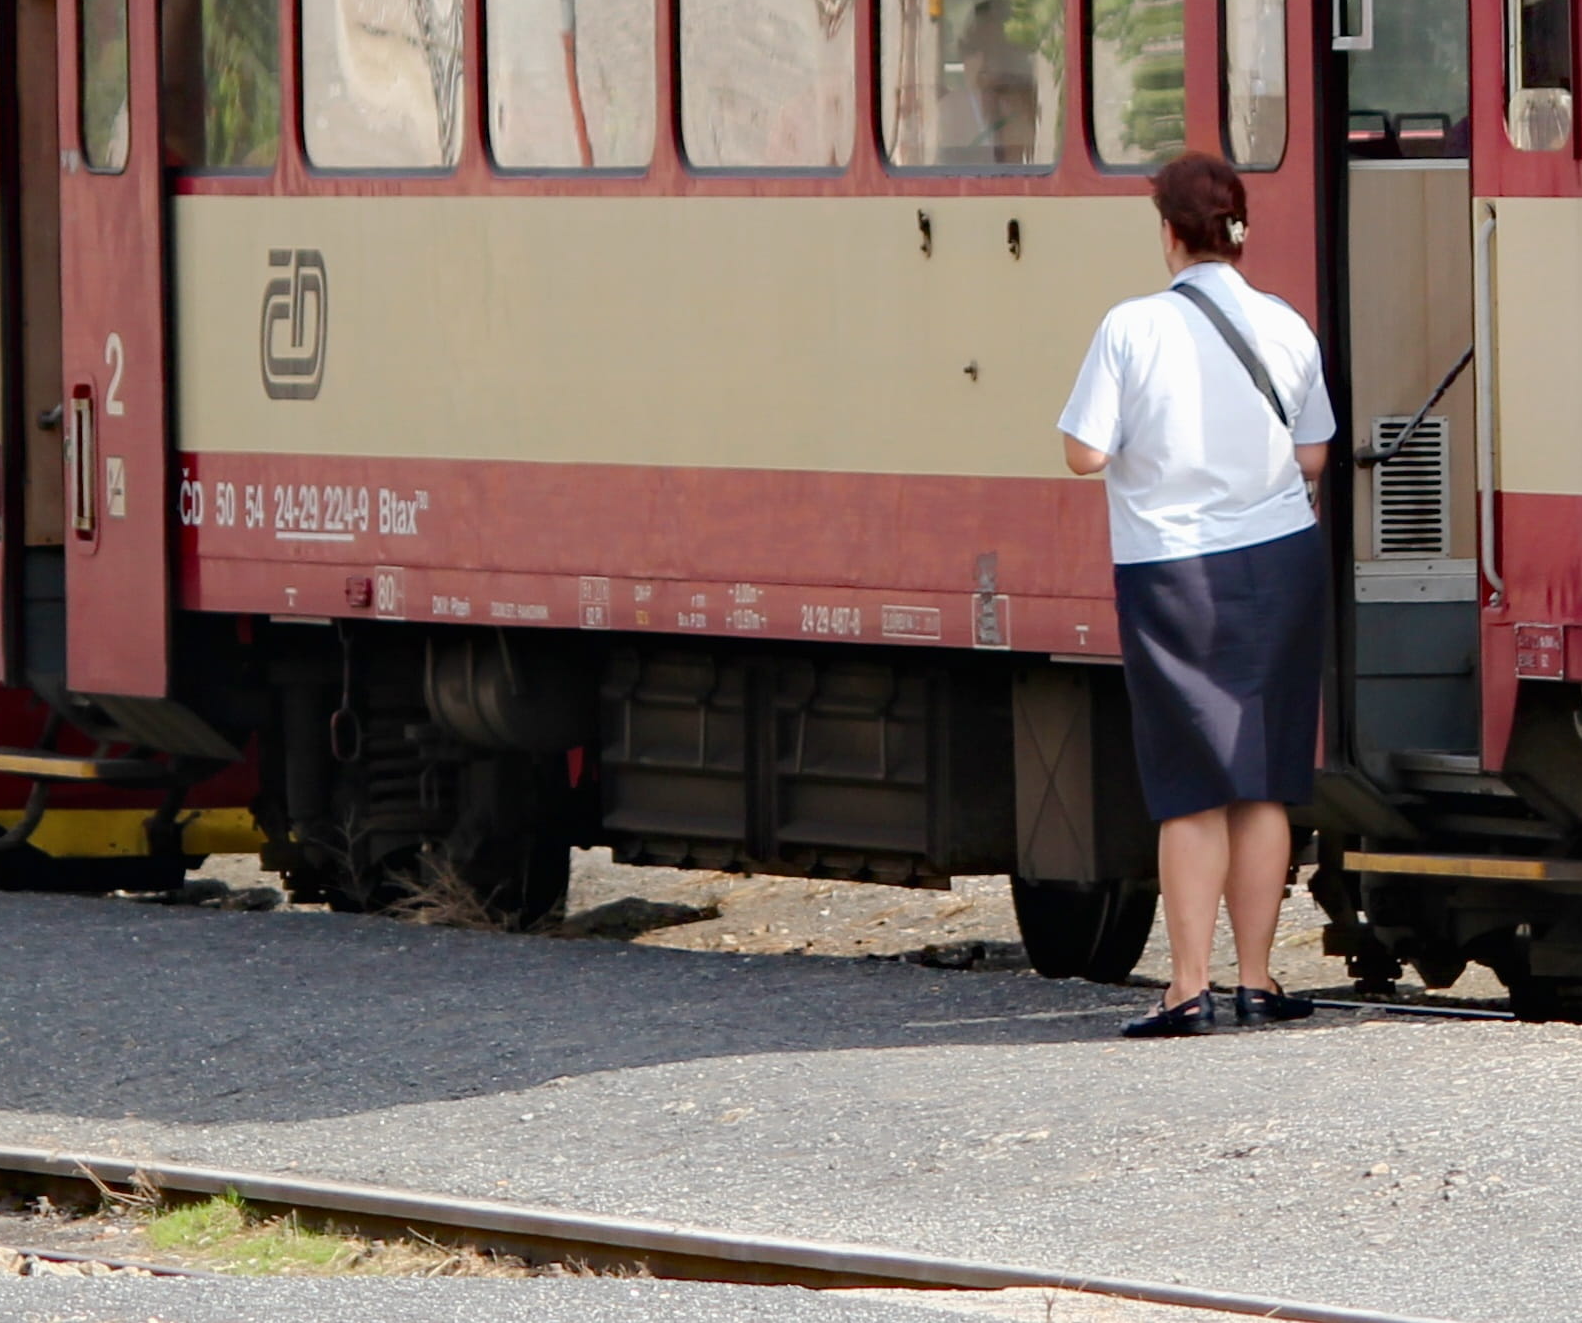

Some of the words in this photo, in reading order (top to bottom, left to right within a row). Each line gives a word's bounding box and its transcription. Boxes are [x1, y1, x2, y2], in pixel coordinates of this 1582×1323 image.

[105, 332, 125, 416] 2
[179, 467, 204, 526] ČD
[215, 482, 236, 527] 50
[245, 483, 265, 529] 54
[274, 484, 318, 531] 24-29
[323, 486, 368, 532] 224-9
[376, 574, 395, 612] 80
